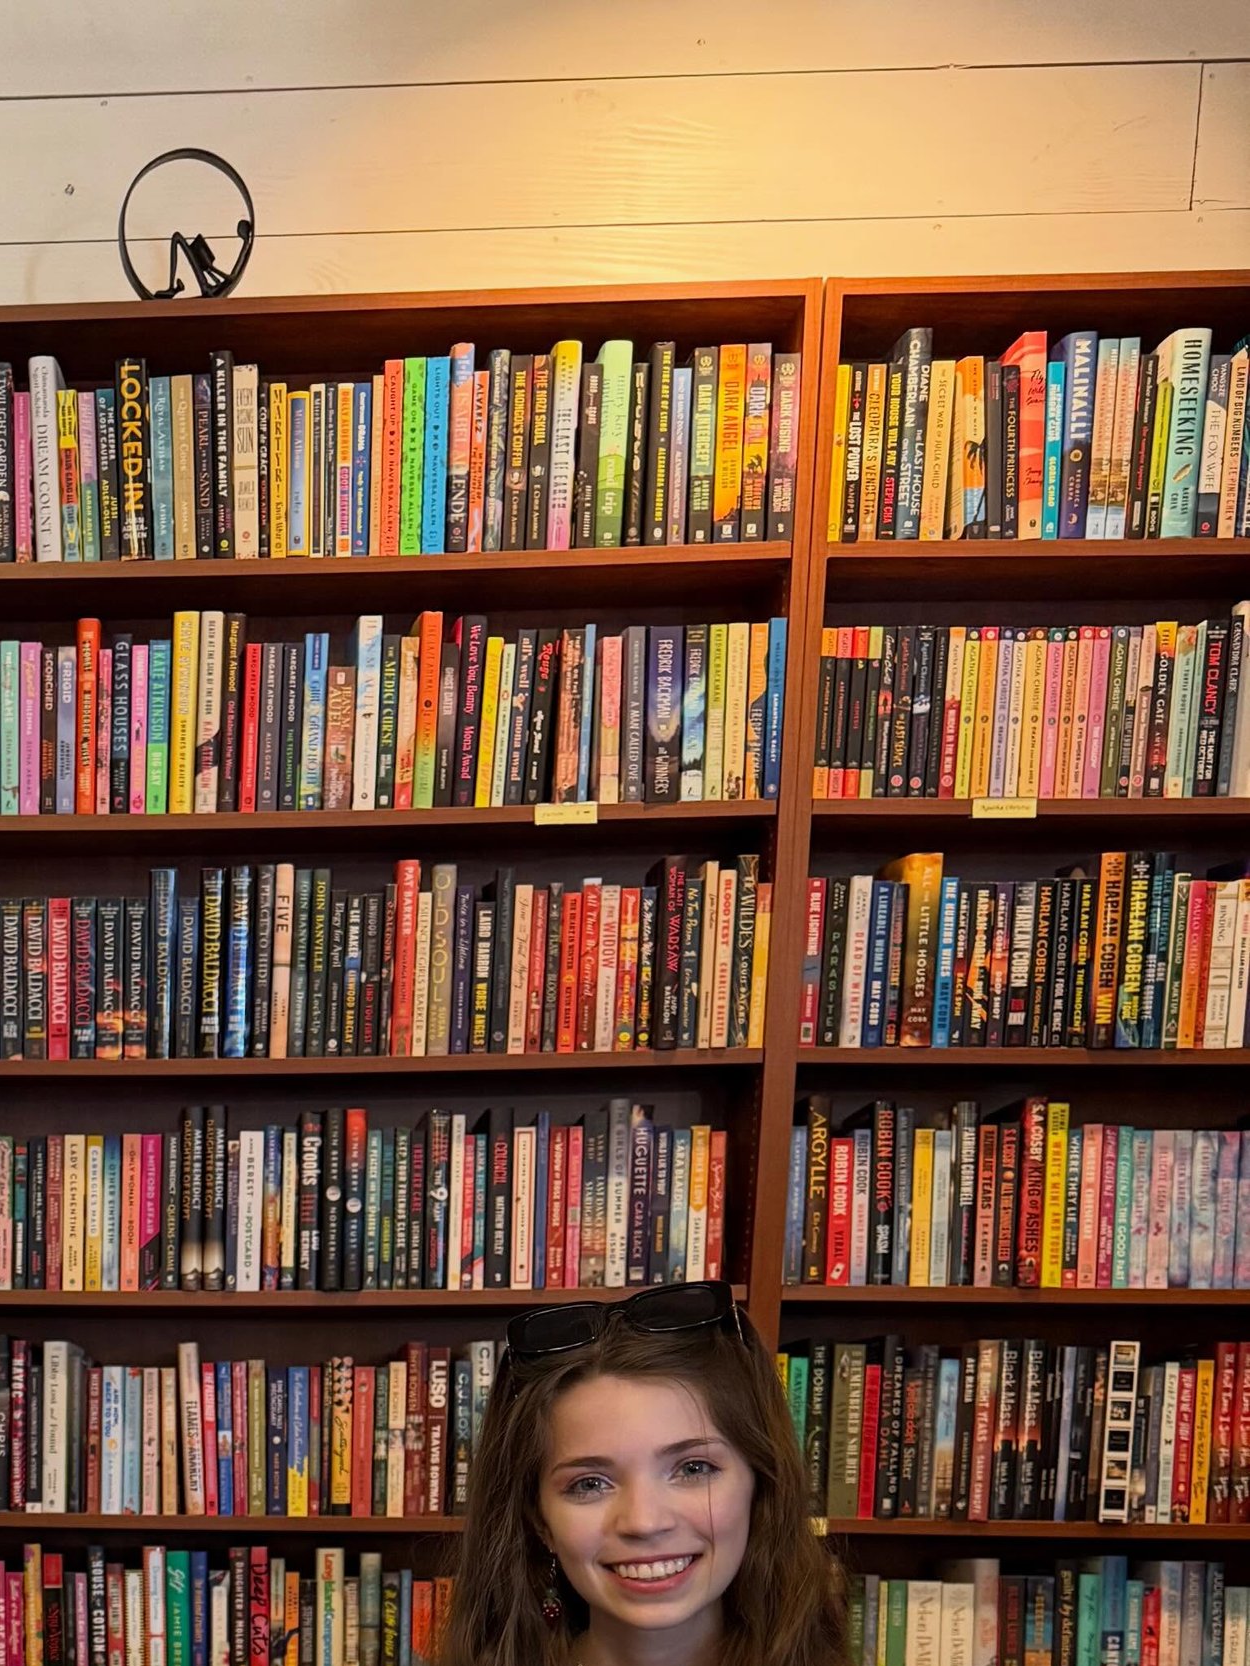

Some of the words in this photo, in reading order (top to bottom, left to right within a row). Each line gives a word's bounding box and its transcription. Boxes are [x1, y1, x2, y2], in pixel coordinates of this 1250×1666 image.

[215, 358, 225, 366] A
[216, 370, 225, 409] KILLER
[1070, 340, 1092, 439] MALINALLI
[1174, 339, 1203, 456] HOMESEEKING
[120, 365, 143, 480] LOCKED
[217, 413, 226, 426] IN
[217, 429, 227, 452] THE
[36, 424, 50, 477] DREAM
[123, 483, 145, 512] IN
[218, 456, 228, 497] FAMILY
[39, 481, 52, 535] COUNT
[113, 642, 129, 690] GLASS
[1209, 641, 1222, 666] TOM
[1204, 669, 1220, 714] CLANCY
[113, 697, 129, 752] HOUSES
[1102, 880, 1122, 937] HARLAN
[51, 918, 68, 959] DAVID
[1101, 943, 1116, 988] COBEN
[51, 963, 68, 1024] BALDACCI
[1094, 993, 1113, 1024] WIN
[633, 1127, 648, 1196] HUGUETTE
[810, 1112, 827, 1199] ARGYLLE
[633, 1201, 644, 1228] CARA
[632, 1230, 643, 1259] BLACK
[429, 1360, 448, 1408] LUSO
[430, 1425, 442, 1463] TRAVIS
[428, 1465, 441, 1511] BOWMAN
